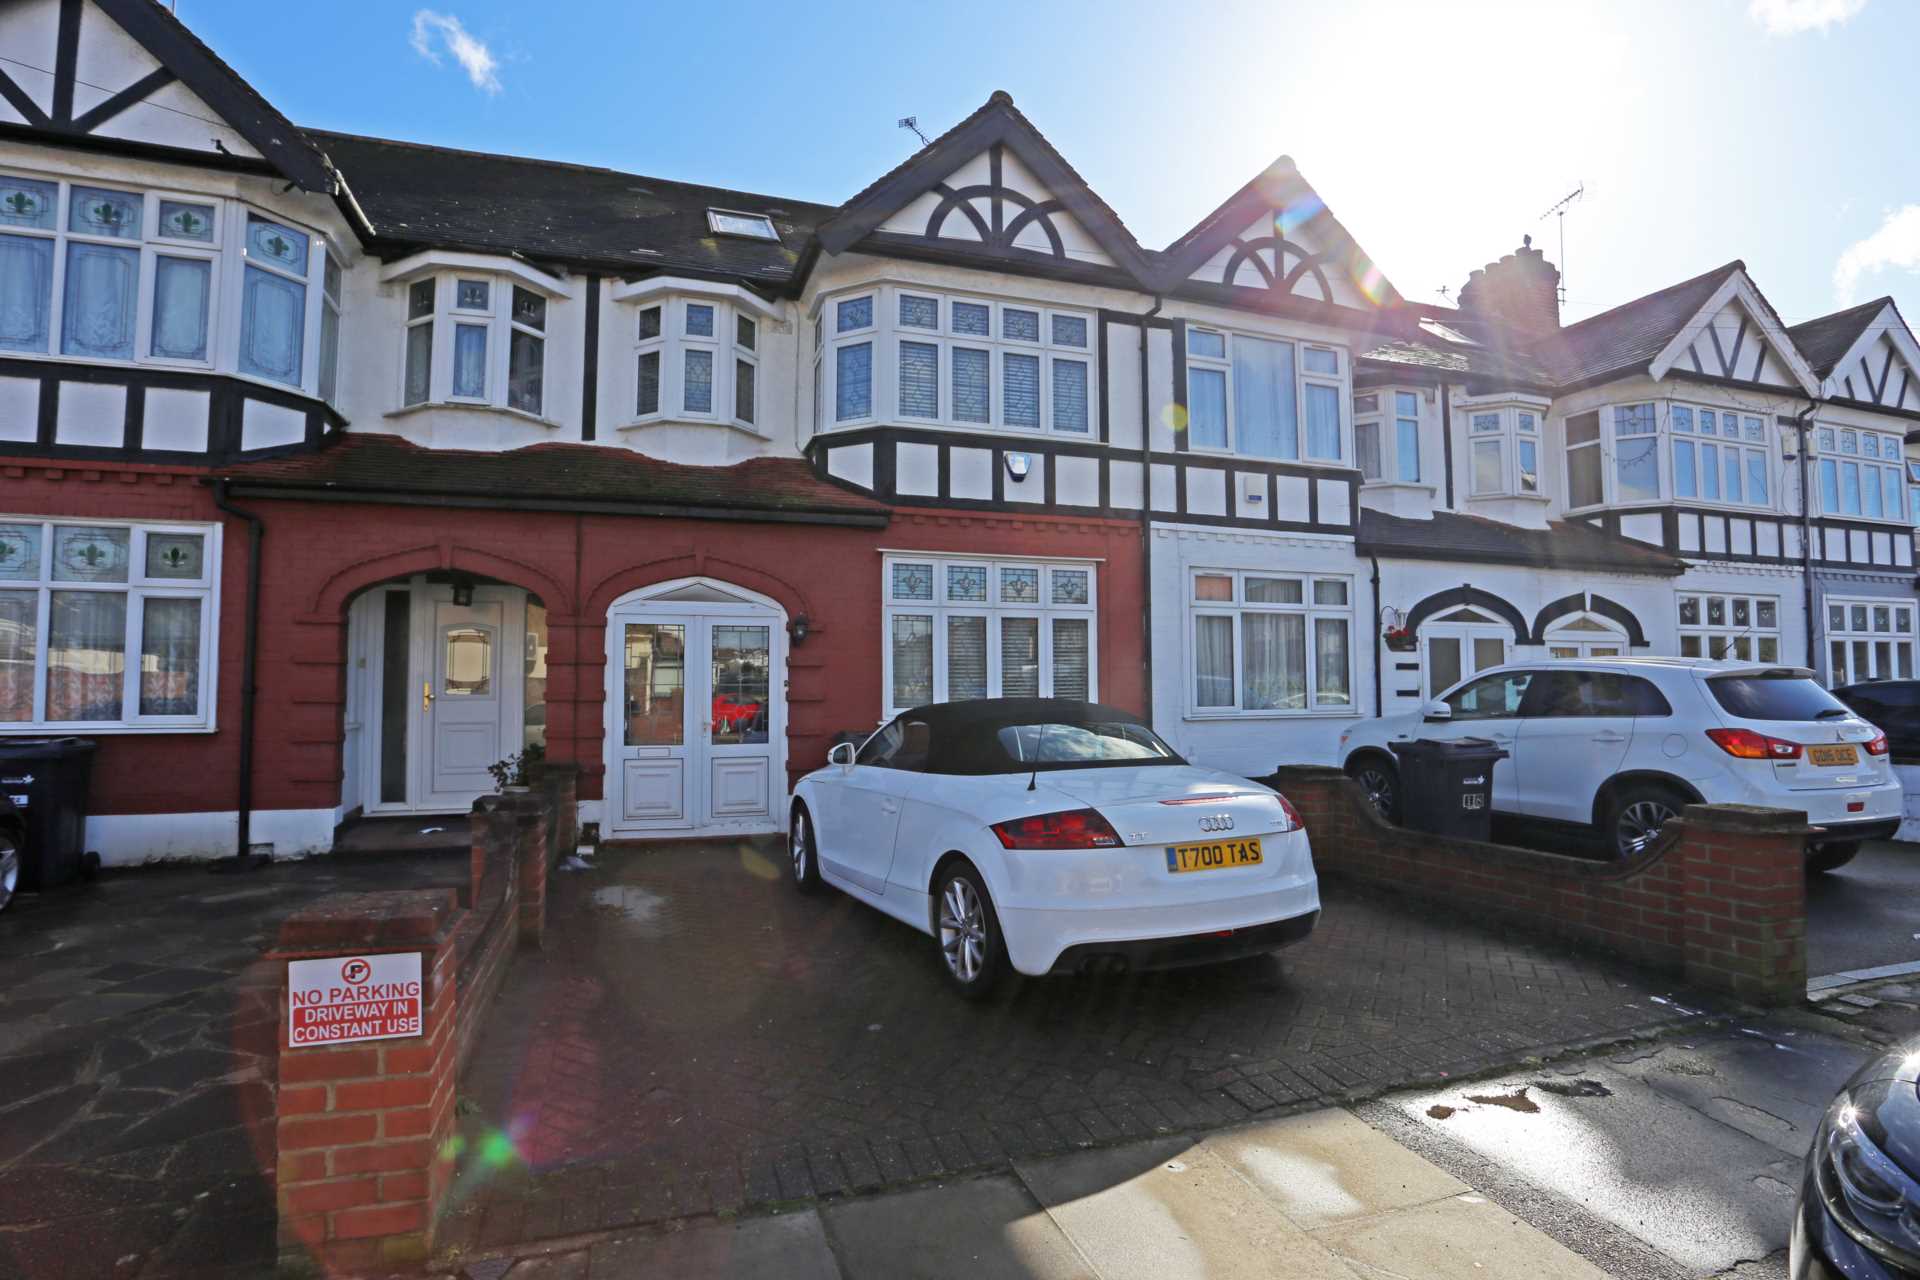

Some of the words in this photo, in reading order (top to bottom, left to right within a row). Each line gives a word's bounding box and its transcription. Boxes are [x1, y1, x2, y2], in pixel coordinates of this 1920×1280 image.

[1178, 846, 1223, 868] T700
[1227, 842, 1260, 863] TAS
[293, 989, 322, 1006] NO
[329, 981, 420, 1003] PARKING
[304, 1002, 389, 1024] DRIVEWAY
[393, 1001, 408, 1015] IN
[294, 1020, 383, 1042] CONSTANT
[387, 1016, 419, 1033] USE
